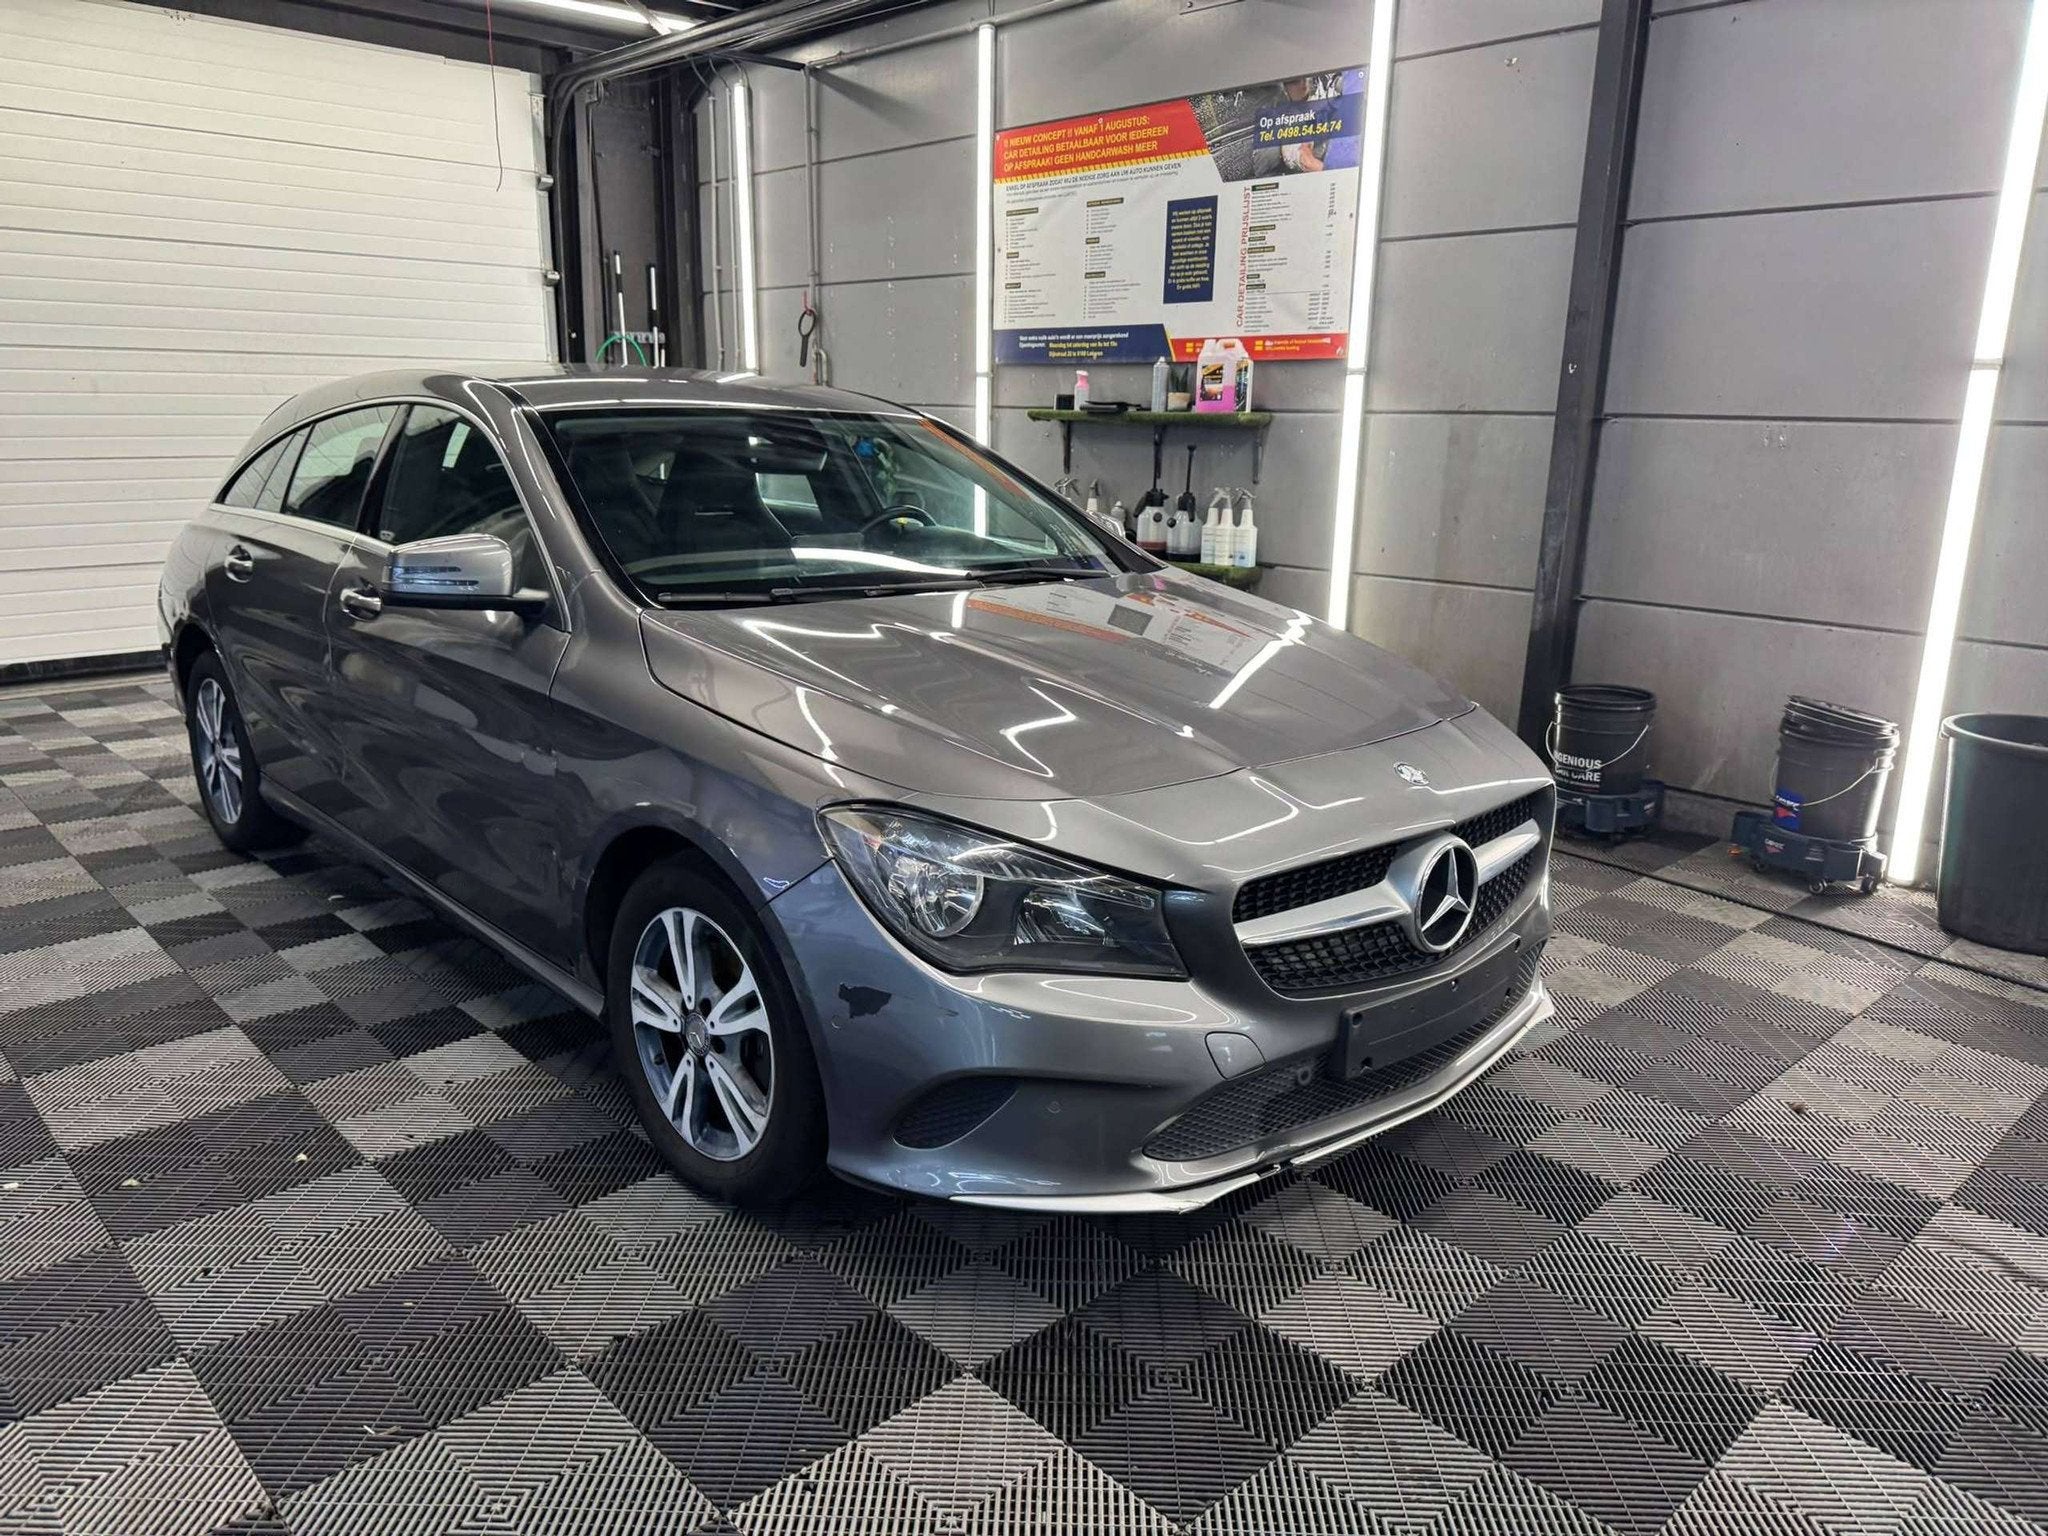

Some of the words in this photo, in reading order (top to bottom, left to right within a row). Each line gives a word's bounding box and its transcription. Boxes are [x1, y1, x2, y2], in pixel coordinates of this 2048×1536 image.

[1010, 136, 1032, 147] NIEUW
[1033, 131, 1066, 144] CONCEPT
[1074, 124, 1098, 136] VANAF
[1100, 123, 1104, 132] 1
[1106, 116, 1150, 130] AUGUSTUS:
[1259, 117, 1273, 129] Op
[1275, 109, 1316, 126] afspraak
[1259, 130, 1275, 141] Tel.
[1277, 119, 1342, 140] 0498.54.54.74
[1004, 149, 1018, 160] CAR
[1018, 144, 1055, 158] DETAILING
[1056, 136, 1104, 153] BETAALBAAR
[1106, 131, 1128, 145] VOOR
[1129, 126, 1169, 141] IEDEREEN
[1004, 161, 1014, 173] OP
[1055, 153, 1075, 166] GEEN
[1076, 146, 1134, 162] HANDCARWASH
[1135, 141, 1158, 153] MEER
[1241, 186, 1250, 245] PRIJSLIJST
[1238, 247, 1247, 302] DETAILING
[1236, 304, 1244, 327] CAR
